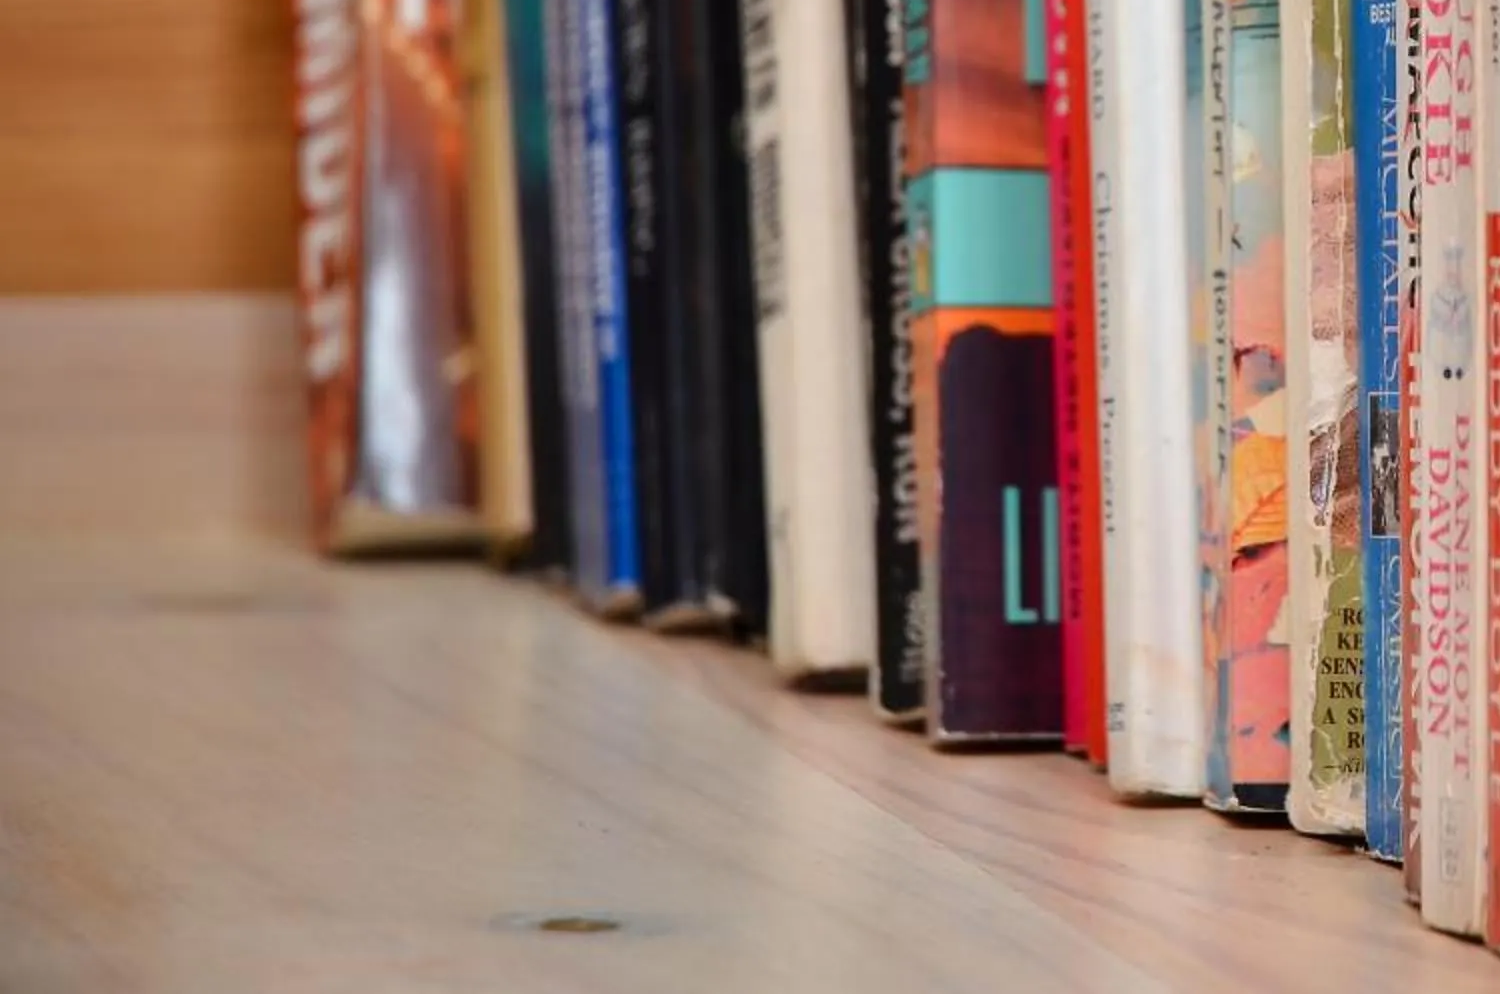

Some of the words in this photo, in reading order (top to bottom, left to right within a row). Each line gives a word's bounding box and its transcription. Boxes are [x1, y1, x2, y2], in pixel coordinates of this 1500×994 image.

[1101, 397, 1117, 536] Present
[1454, 414, 1471, 592] DIANE
[1428, 446, 1451, 738] DAVIDSON
[1322, 707, 1336, 725] A
[1347, 708, 1365, 725] S
[1347, 731, 1365, 749] R
[1454, 609, 1471, 779] MOTT
